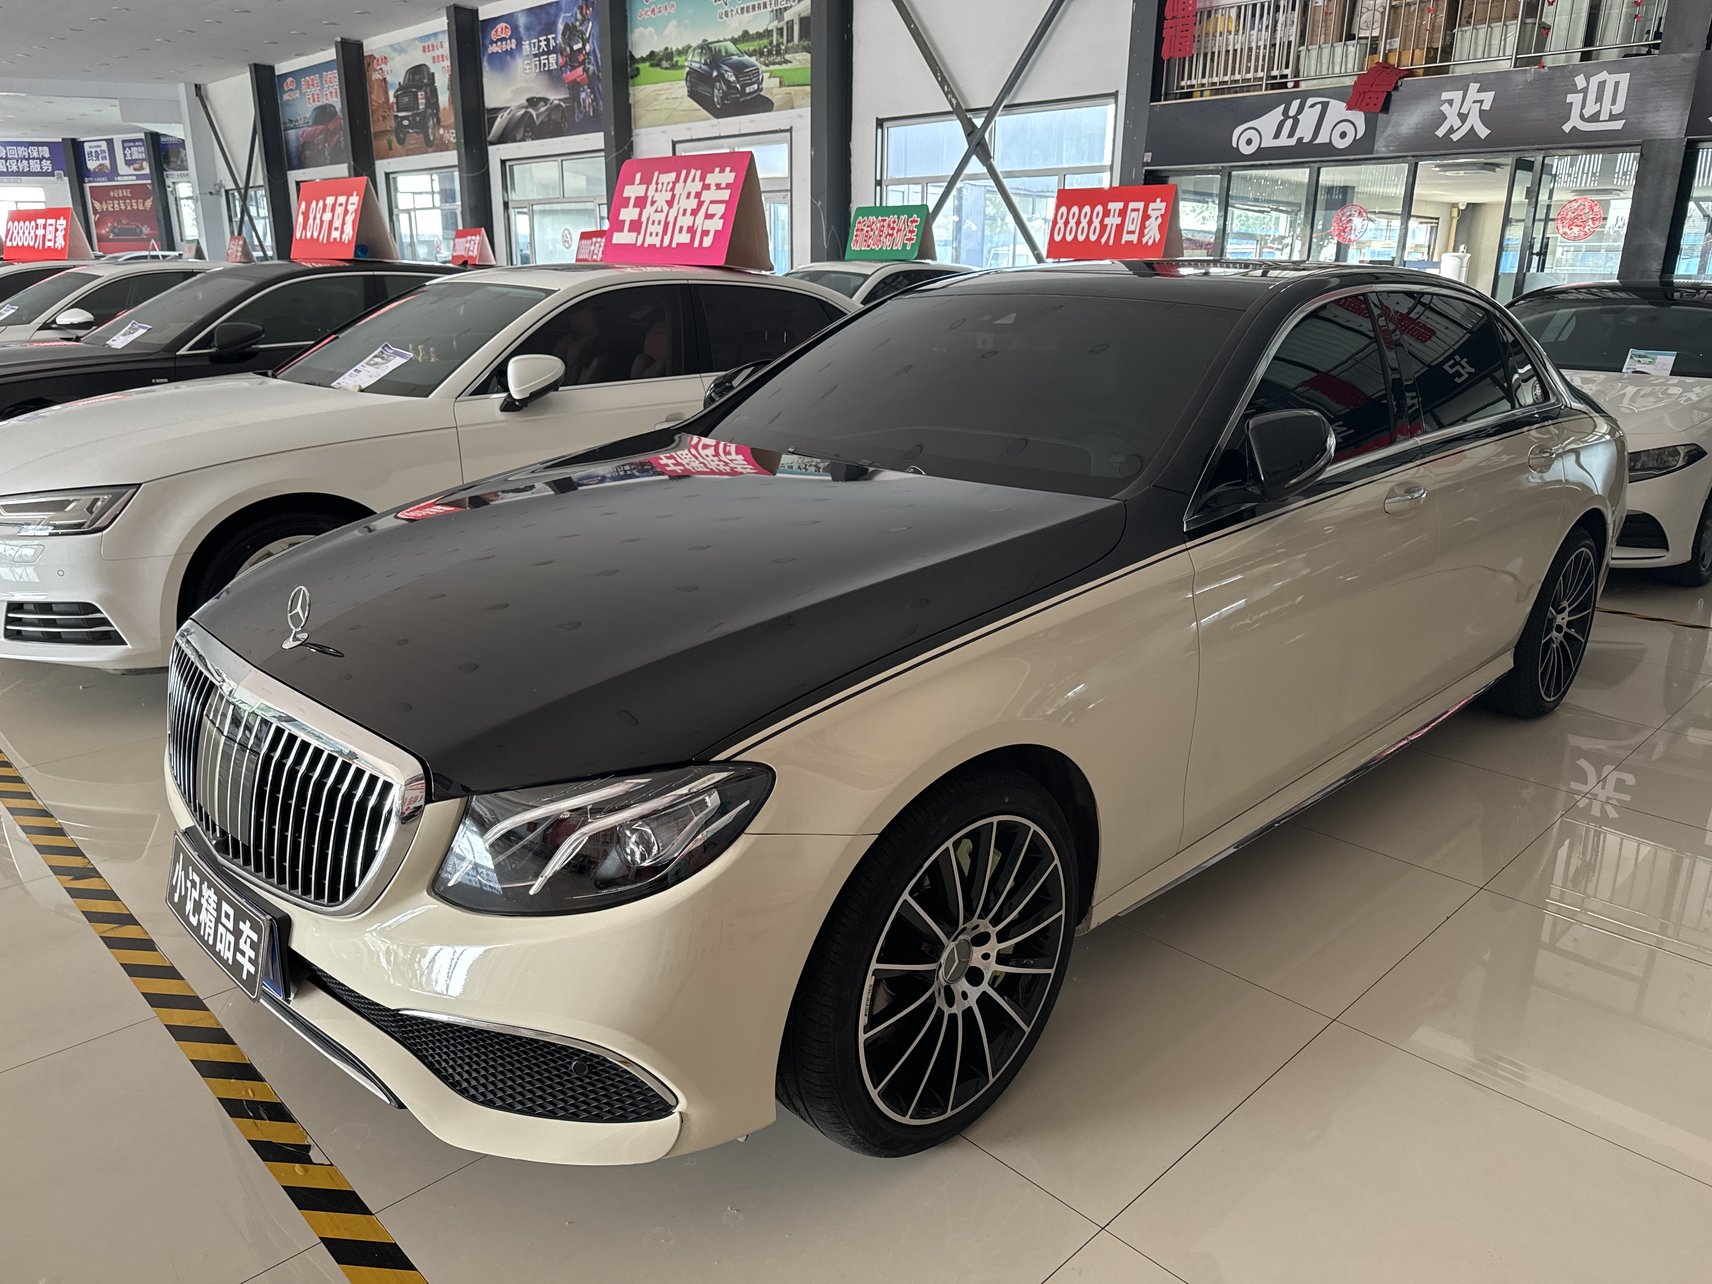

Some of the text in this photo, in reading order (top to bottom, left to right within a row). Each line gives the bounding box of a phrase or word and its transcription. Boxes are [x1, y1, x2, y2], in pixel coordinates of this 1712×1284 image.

[1434, 70, 1632, 143] 欢迎
[6, 218, 67, 250] 28888开回家
[296, 191, 360, 244] 6.88开回家
[611, 166, 737, 249] 主播推荐
[850, 214, 921, 251] 新能源特价车
[1053, 197, 1168, 247] 8888开回家
[172, 852, 258, 980] 小记精品车
